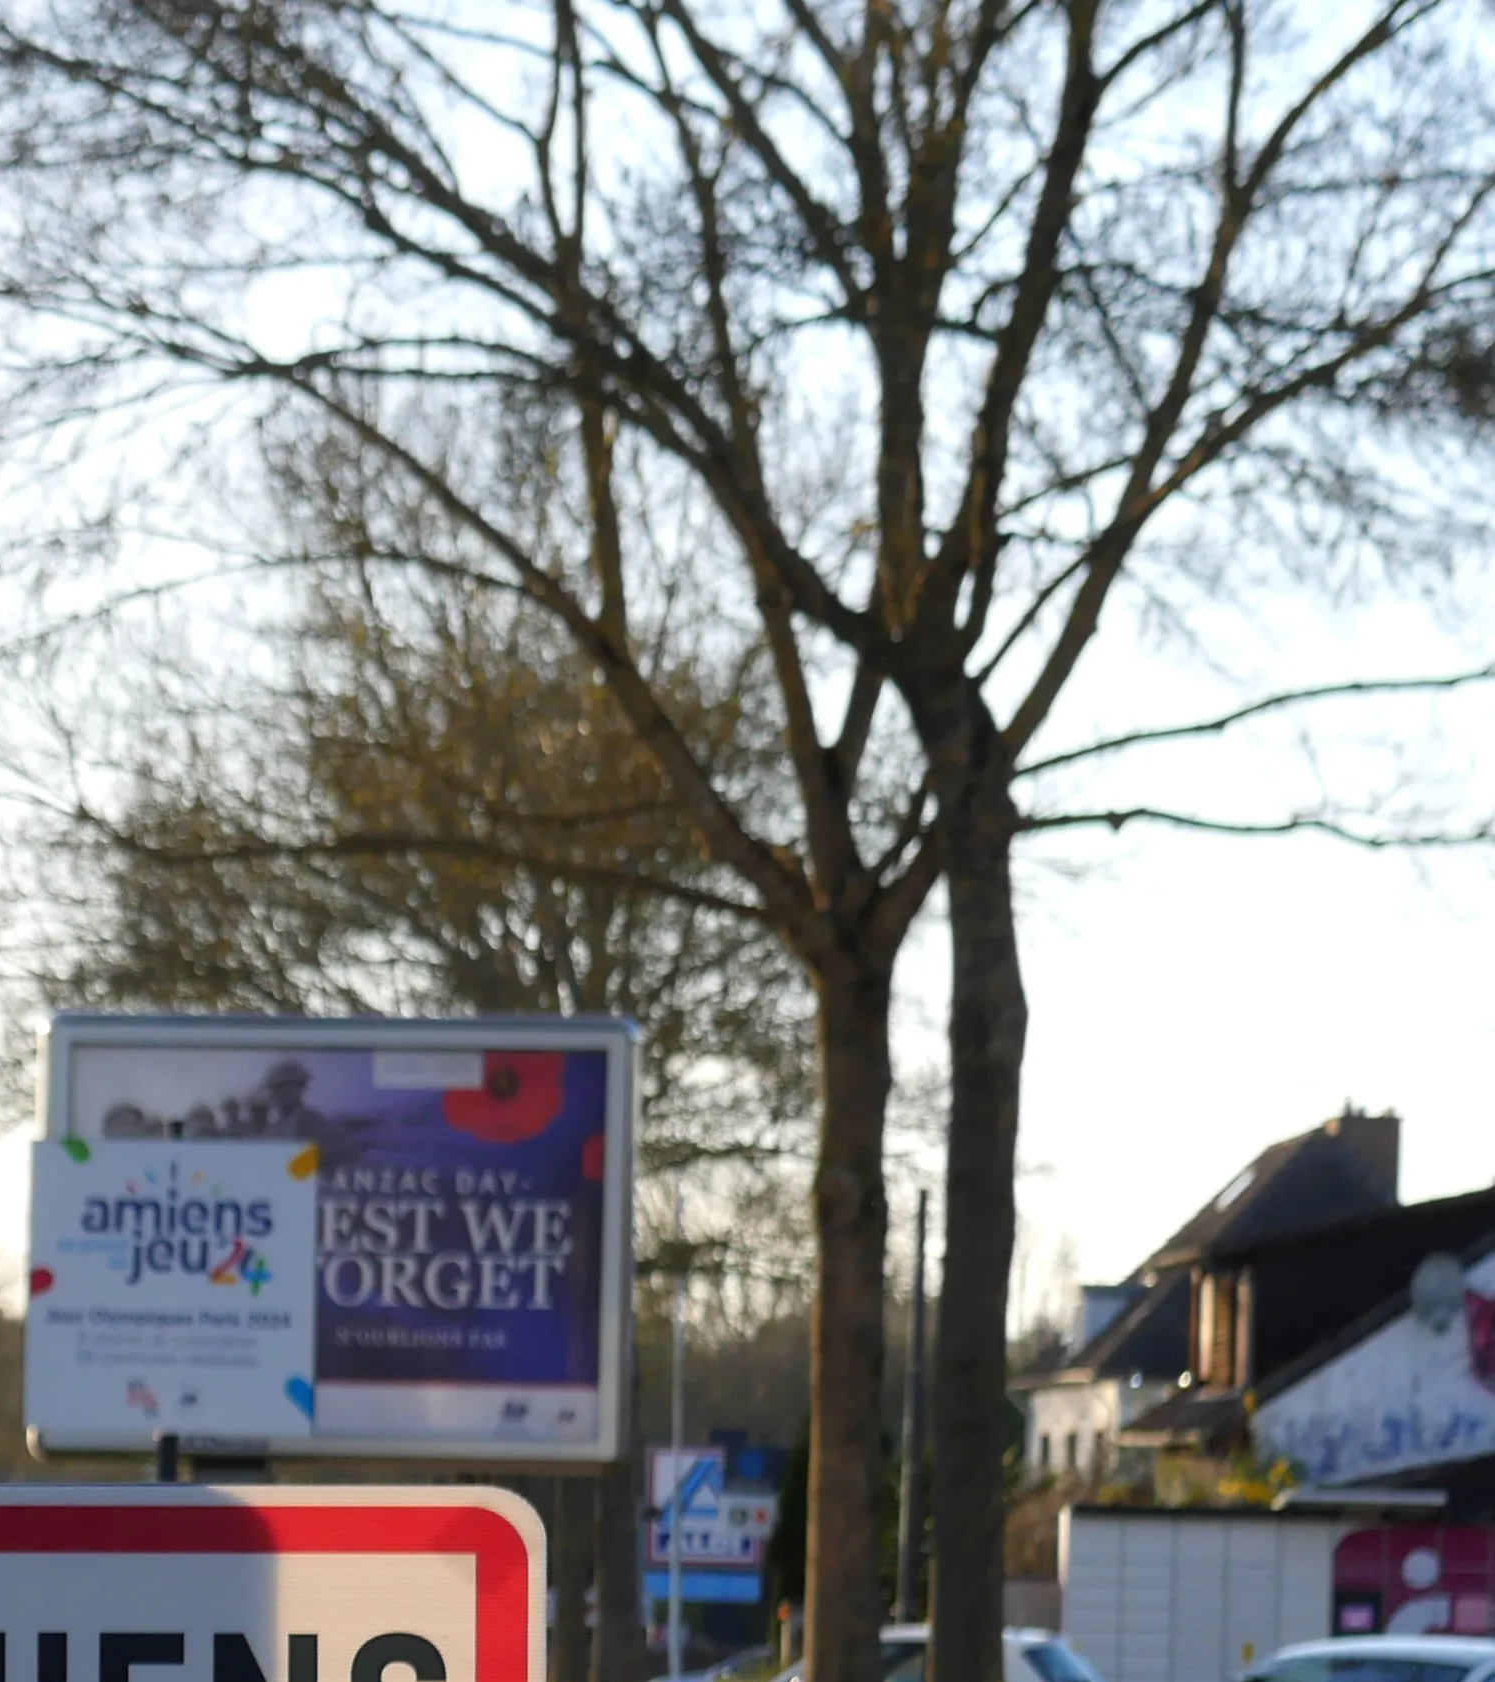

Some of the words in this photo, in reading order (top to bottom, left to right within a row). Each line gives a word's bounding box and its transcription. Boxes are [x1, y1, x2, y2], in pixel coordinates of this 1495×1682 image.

[82, 1190, 273, 1247] amiens
[318, 1198, 447, 1254] EST
[460, 1200, 574, 1257] WE
[316, 1252, 566, 1311] ORGET
